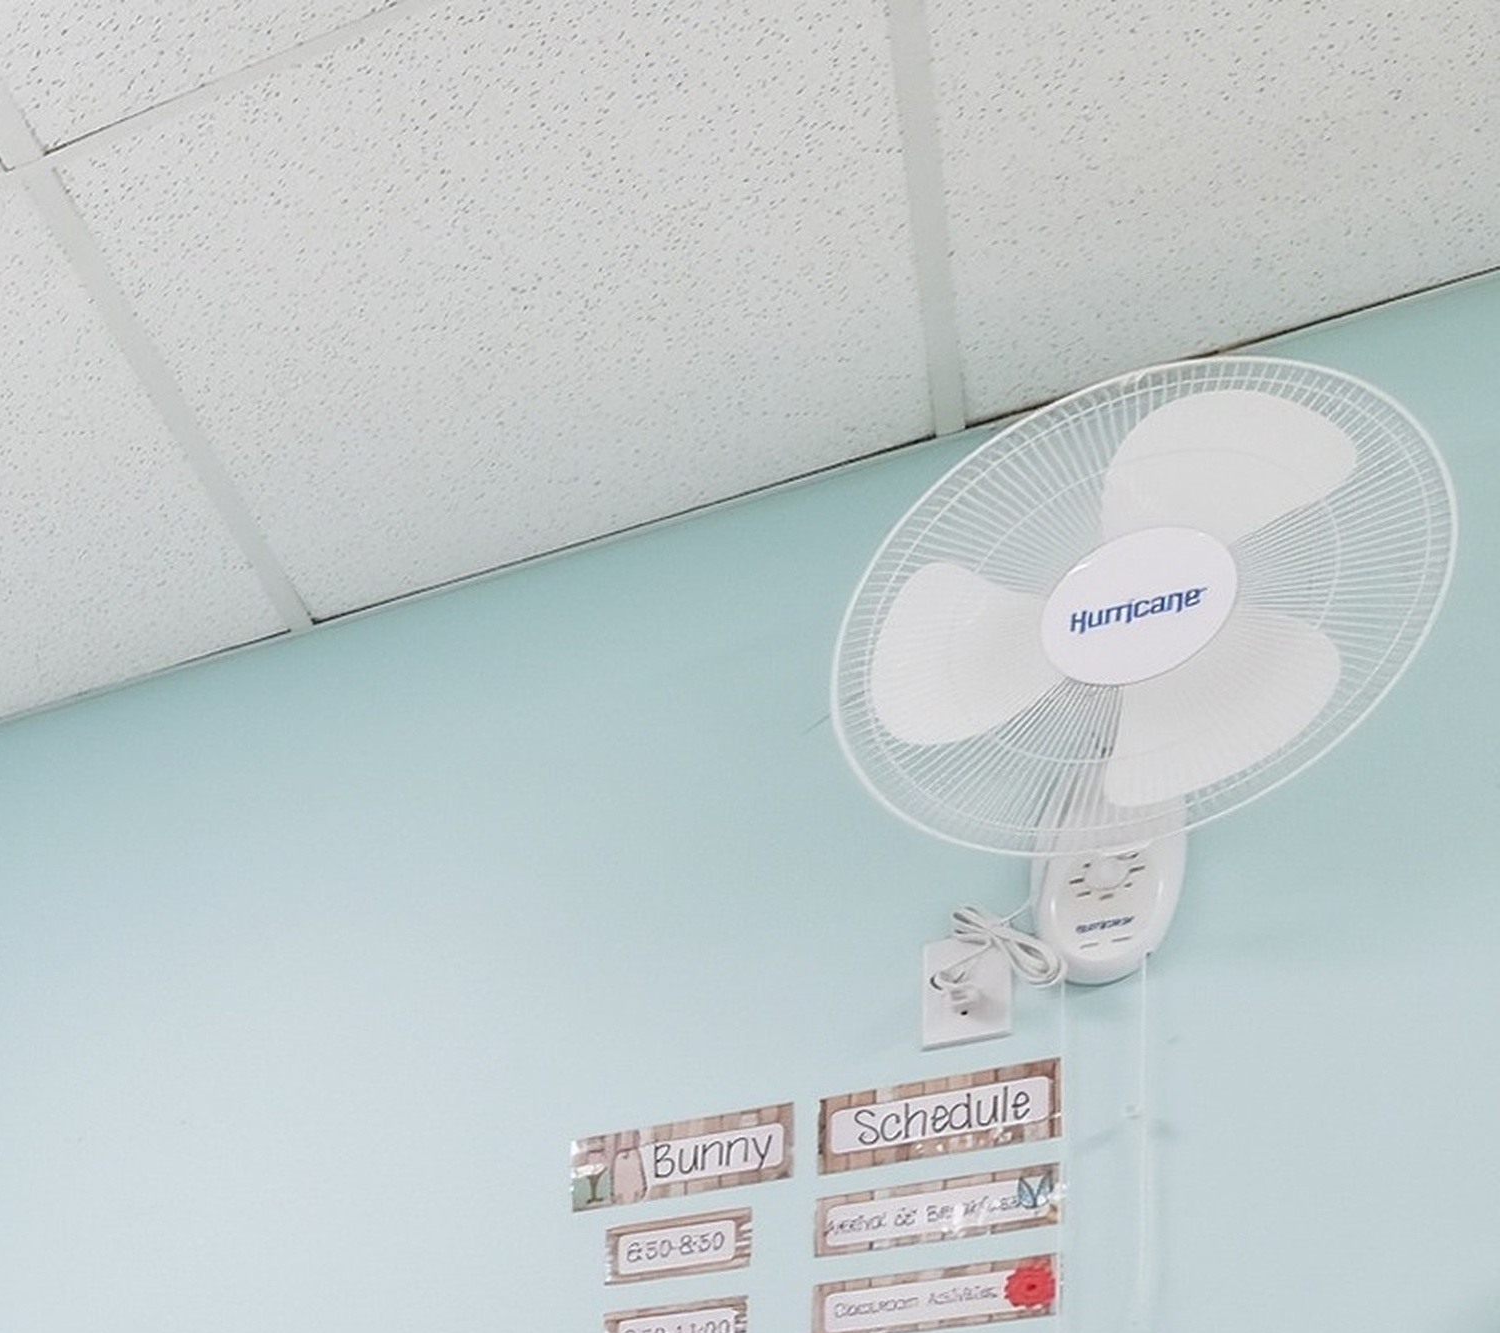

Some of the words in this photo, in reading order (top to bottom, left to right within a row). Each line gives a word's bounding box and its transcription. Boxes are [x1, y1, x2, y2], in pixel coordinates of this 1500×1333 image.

[1070, 587, 1209, 634] Hurricane
[853, 1085, 1031, 1146] Schedule
[653, 1133, 774, 1179] Bunny
